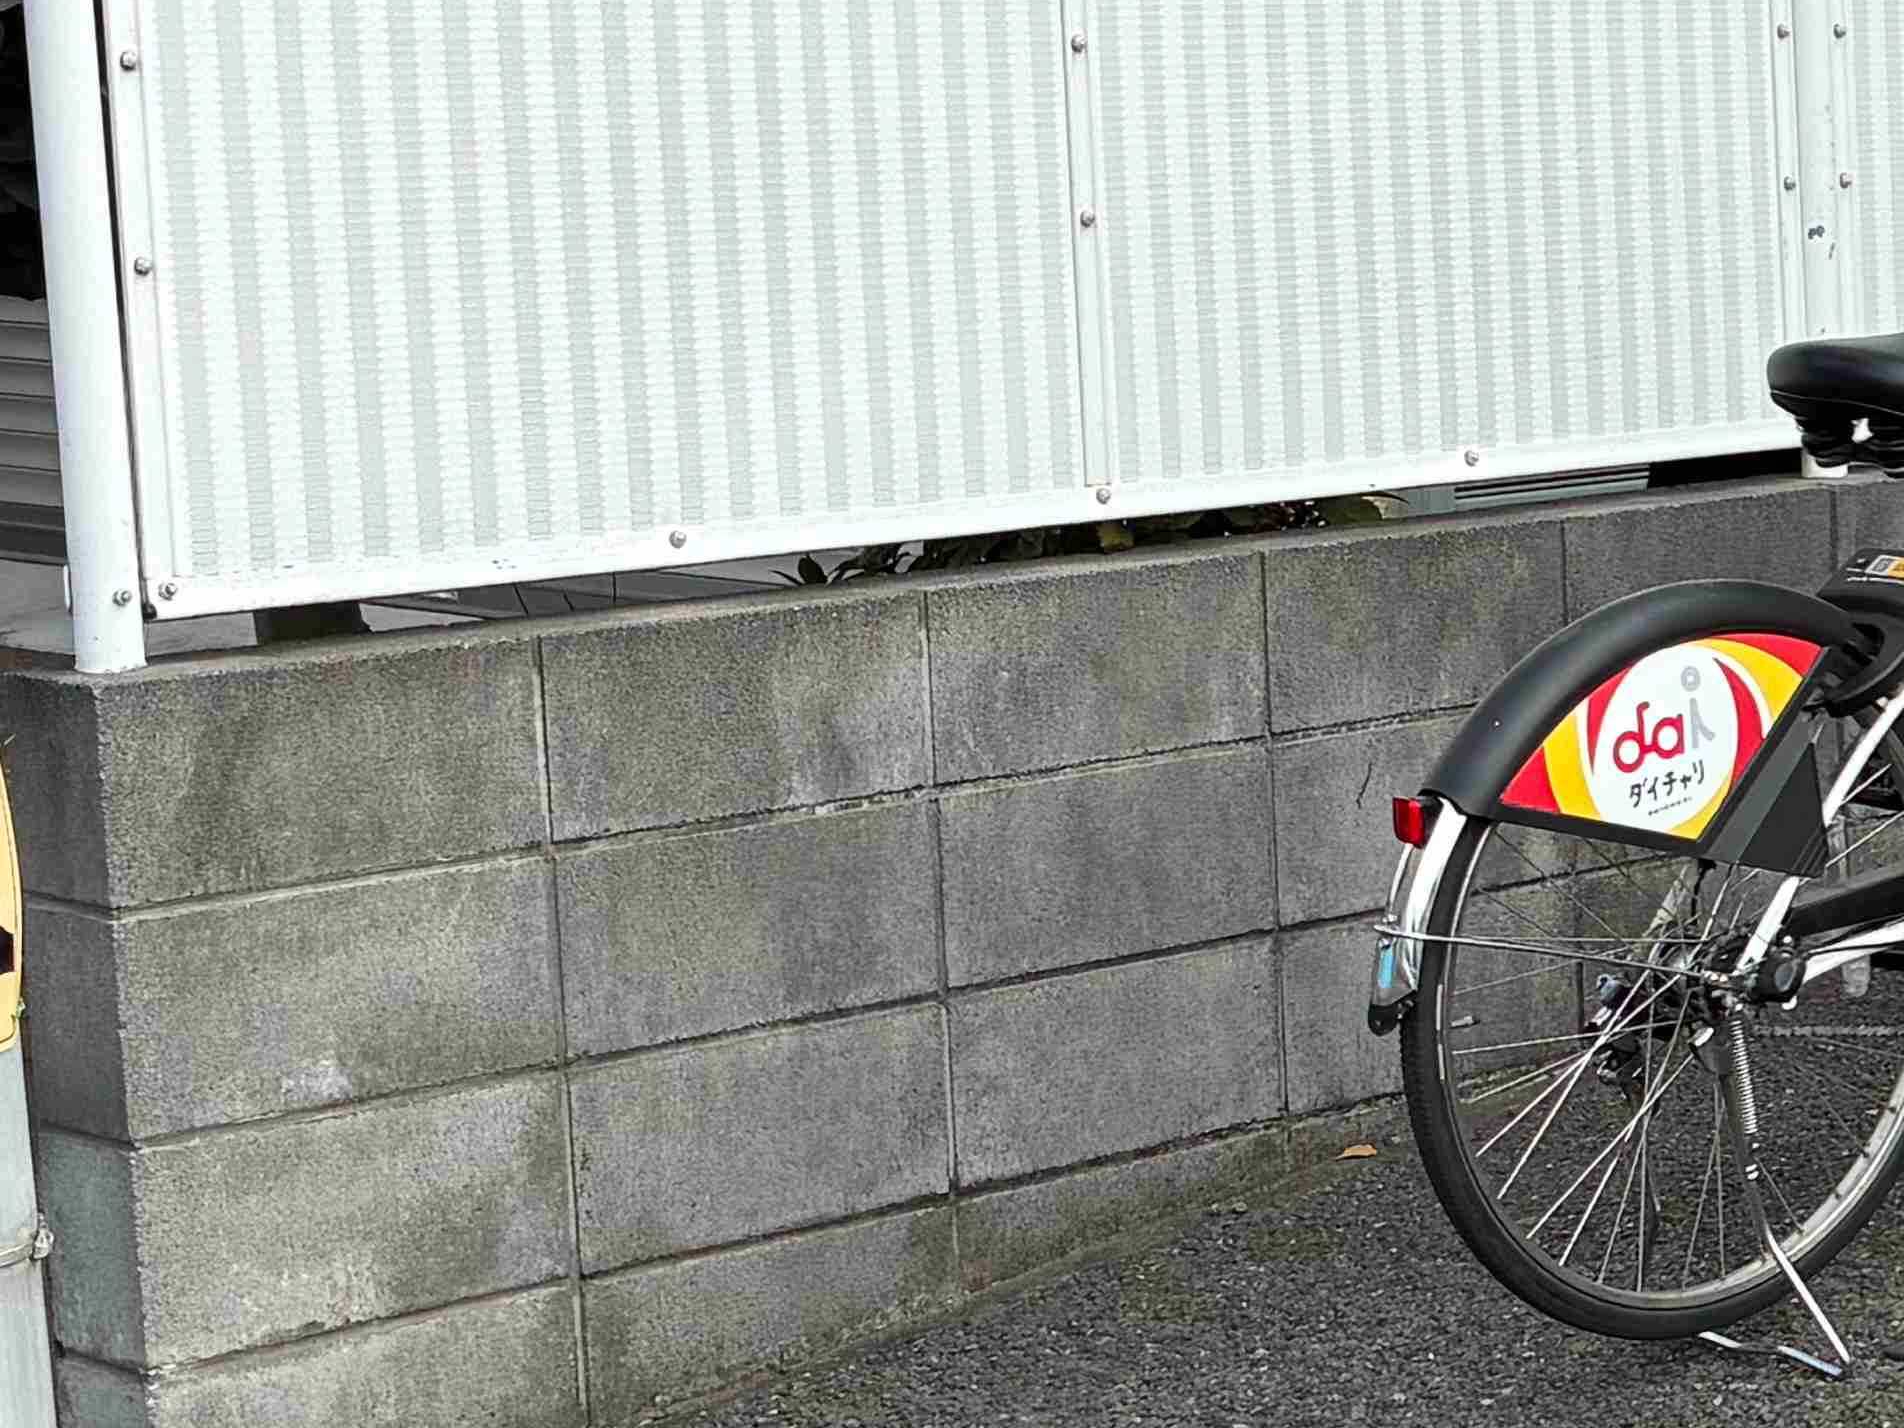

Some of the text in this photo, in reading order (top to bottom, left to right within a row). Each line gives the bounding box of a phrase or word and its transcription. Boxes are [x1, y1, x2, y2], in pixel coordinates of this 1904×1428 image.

[1612, 665, 1717, 774] dai
[1629, 758, 1706, 809] ダイチャリ
